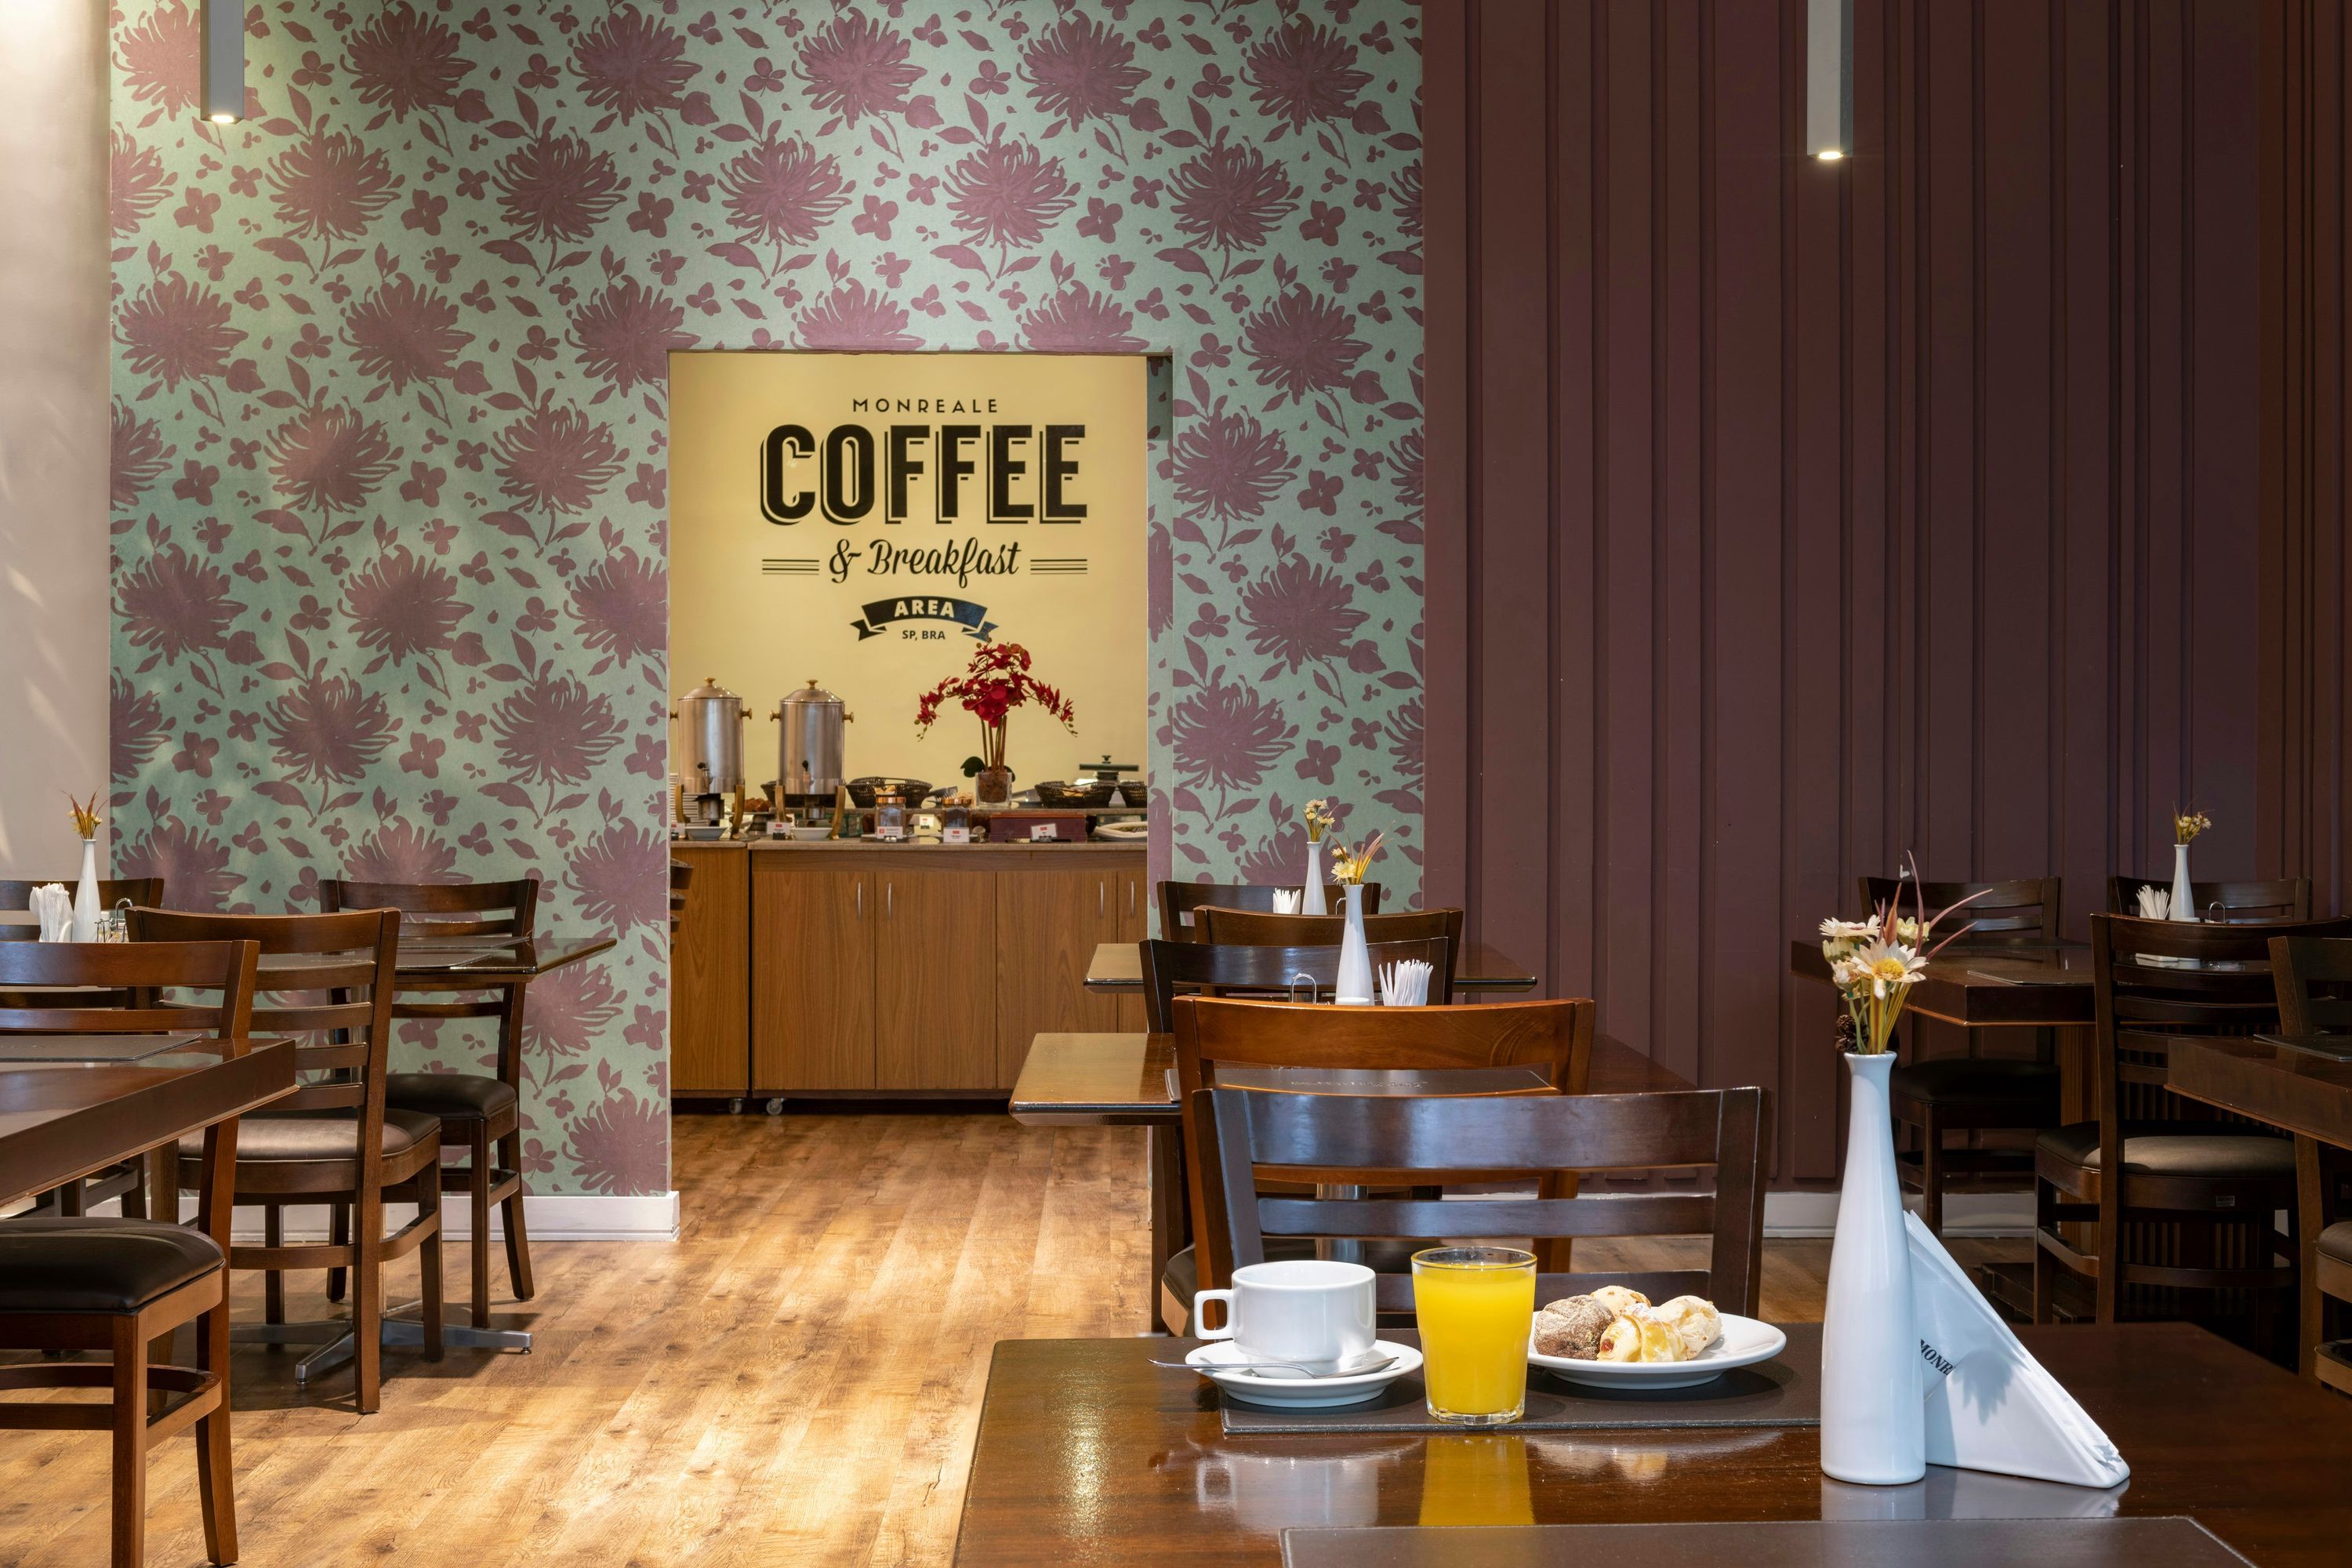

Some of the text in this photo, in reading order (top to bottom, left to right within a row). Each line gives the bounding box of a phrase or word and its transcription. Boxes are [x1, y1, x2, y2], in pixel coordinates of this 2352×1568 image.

[852, 397, 998, 413] MONREALE
[760, 423, 1087, 526] COFFEE
[829, 537, 1022, 589] & Breakfast
[894, 599, 955, 618] AREA
[902, 630, 946, 641] SP, BRA
[1920, 1338, 1956, 1376] MONR
